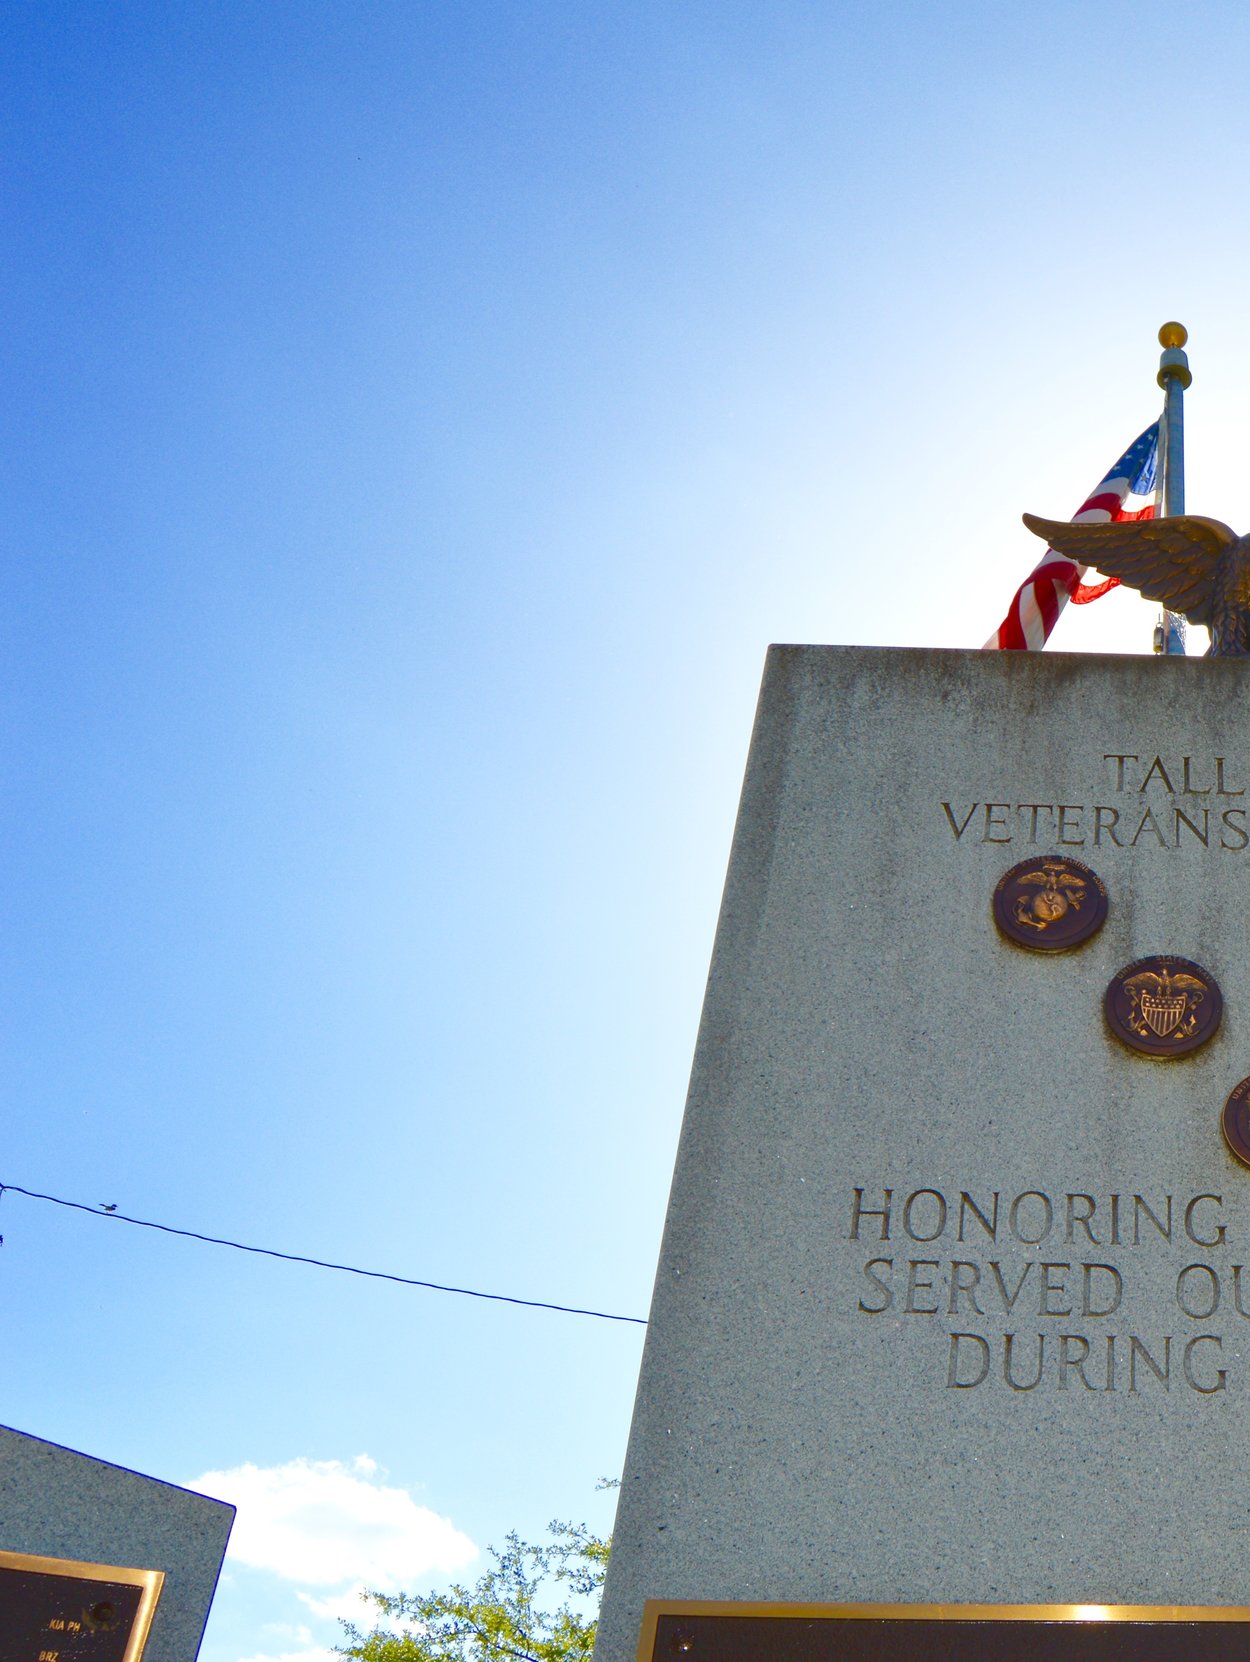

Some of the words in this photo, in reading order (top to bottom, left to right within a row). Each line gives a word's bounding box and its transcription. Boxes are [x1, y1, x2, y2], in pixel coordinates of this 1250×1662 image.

[941, 801, 1249, 851] VETERANS
[1062, 856, 1089, 873] MARINE
[1092, 875, 1108, 897] CORPS
[849, 1187, 1228, 1248] HONORING
[858, 1257, 1123, 1317] SERVED
[946, 1332, 1227, 1394] DURING
[48, 1618, 64, 1630] KIA
[67, 1621, 81, 1632] PH
